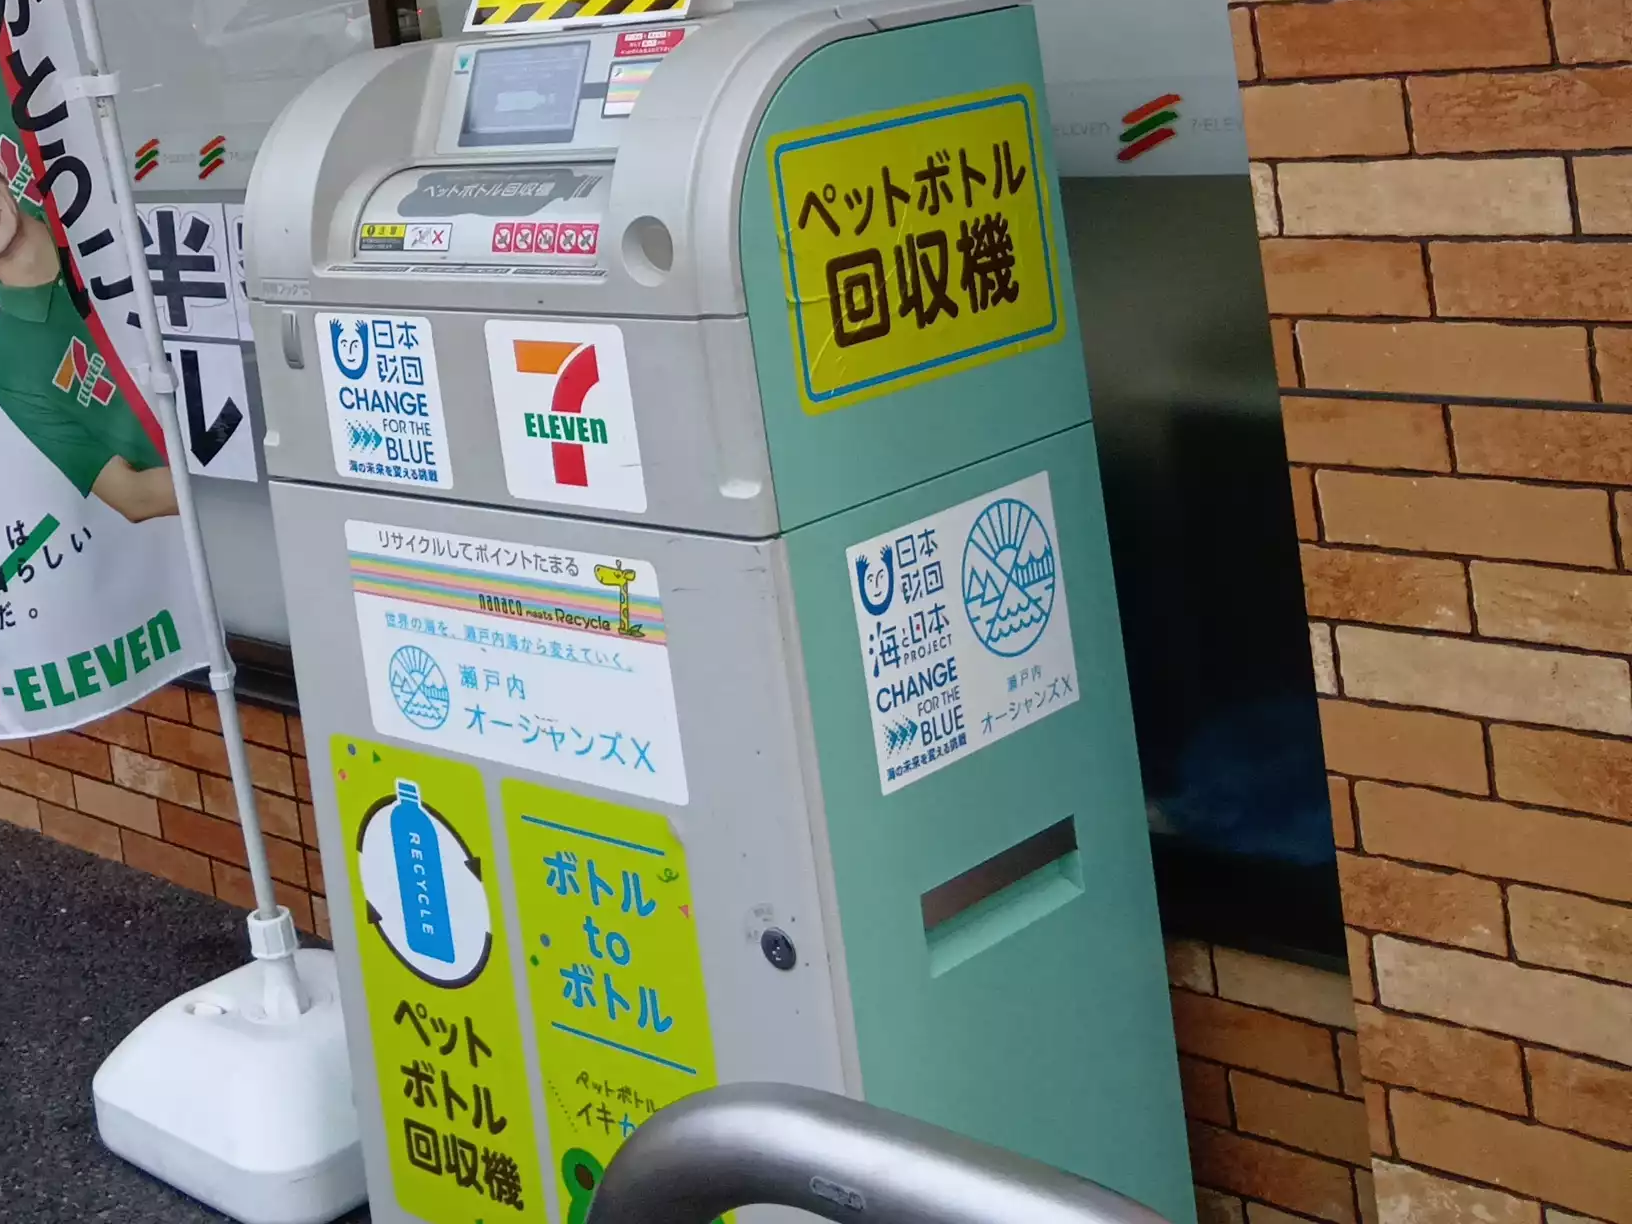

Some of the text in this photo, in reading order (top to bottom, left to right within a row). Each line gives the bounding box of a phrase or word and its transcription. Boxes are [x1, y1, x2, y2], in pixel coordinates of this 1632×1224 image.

[796, 139, 1027, 238] ペットボトル
[824, 211, 1020, 349] 回収機
[372, 319, 419, 350] 日本
[376, 354, 425, 387] 財団
[338, 386, 430, 418] CHANGE
[382, 418, 432, 437] FOR THE
[384, 436, 437, 466] BLUE
[377, 529, 580, 578] リサイクルしてポイントたまる
[894, 528, 939, 569] 日本
[900, 560, 945, 604] 財団
[478, 592, 523, 617] nanaco
[554, 607, 611, 631] Recycle
[868, 602, 950, 678] 海と日本
[902, 633, 953, 665] PROJECT
[458, 662, 527, 701] 瀬戸内
[876, 656, 959, 714] CHANGE
[1006, 664, 1043, 691] 瀬戸内
[917, 685, 961, 717] FOR THE
[981, 673, 1073, 735] オーシャンズX
[920, 704, 966, 747] BLUE
[408, 832, 435, 936] RECYCLE
[542, 850, 657, 918] ボトル
[583, 916, 631, 967] to
[558, 962, 674, 1034] ボトル
[393, 999, 493, 1068] ペット
[399, 1059, 508, 1136] ボトル
[575, 1070, 661, 1114] ペットボトル
[575, 1101, 637, 1138] イキカ
[403, 1117, 525, 1212] 回収機
